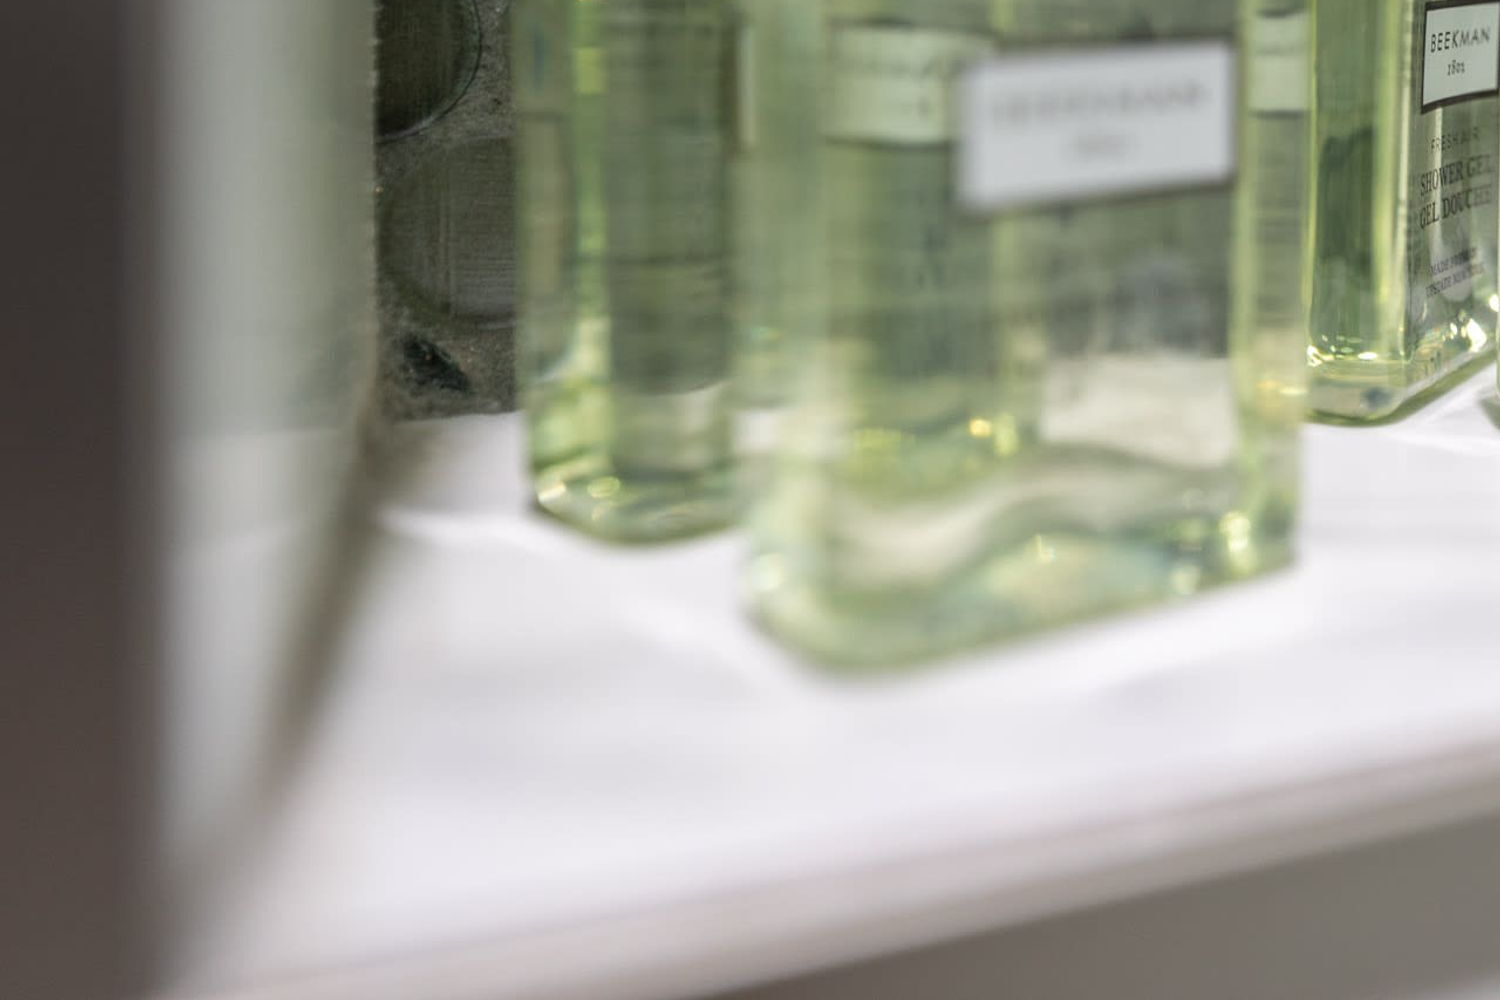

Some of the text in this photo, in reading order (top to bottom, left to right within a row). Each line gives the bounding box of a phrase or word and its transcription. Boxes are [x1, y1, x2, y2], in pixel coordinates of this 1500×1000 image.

[1430, 27, 1490, 53] BEEKMAN
[1420, 160, 1464, 197] SHOWER
[1419, 201, 1439, 230] GEL
